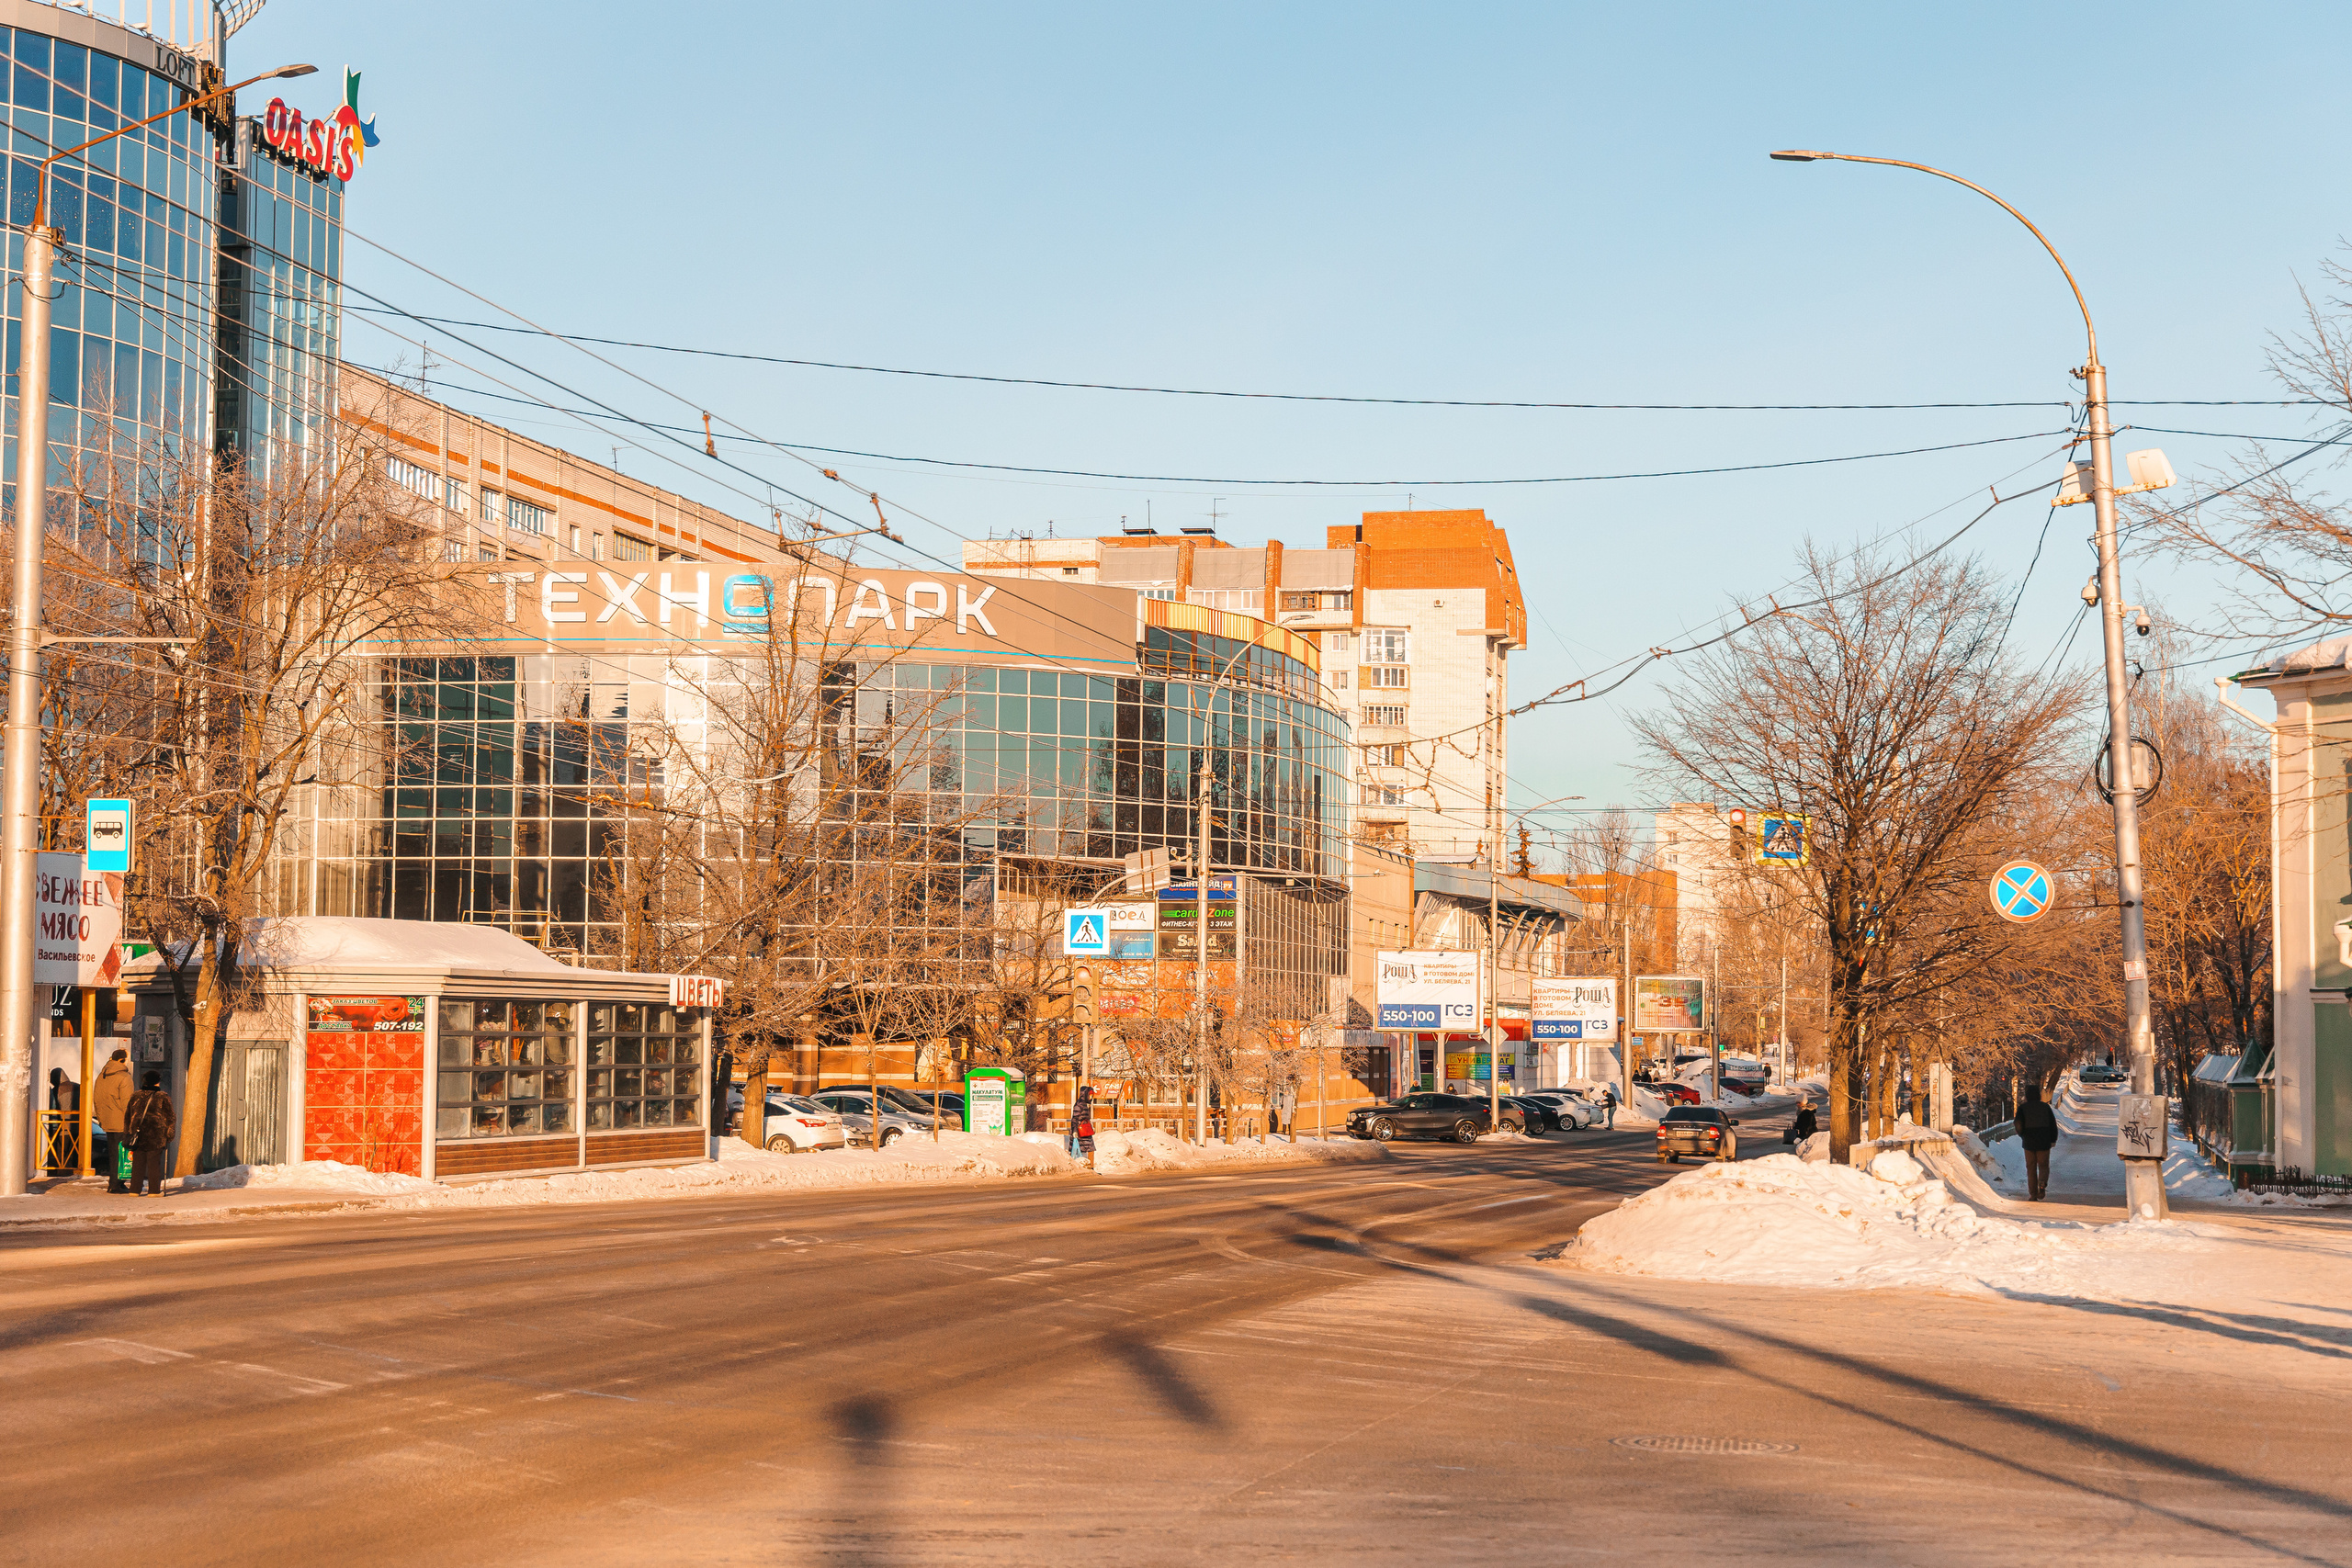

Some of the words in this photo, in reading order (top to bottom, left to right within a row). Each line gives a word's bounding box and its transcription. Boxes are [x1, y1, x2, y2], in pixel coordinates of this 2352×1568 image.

[156, 46, 195, 85] LOFT
[263, 96, 354, 182] OASIS
[488, 571, 998, 637] ТЕХНОПАРК
[40, 911, 90, 942] МЯСО
[38, 948, 96, 962] Васильевское
[676, 977, 724, 1012] ЦВЕТЫ
[408, 998, 424, 1008] 24
[1383, 1010, 1435, 1021] 550-100
[1445, 1004, 1474, 1017] ГСЗ
[374, 1021, 424, 1031] 507-192
[1537, 1025, 1577, 1033] 550-100
[1586, 1020, 1608, 1030] ГСЗ
